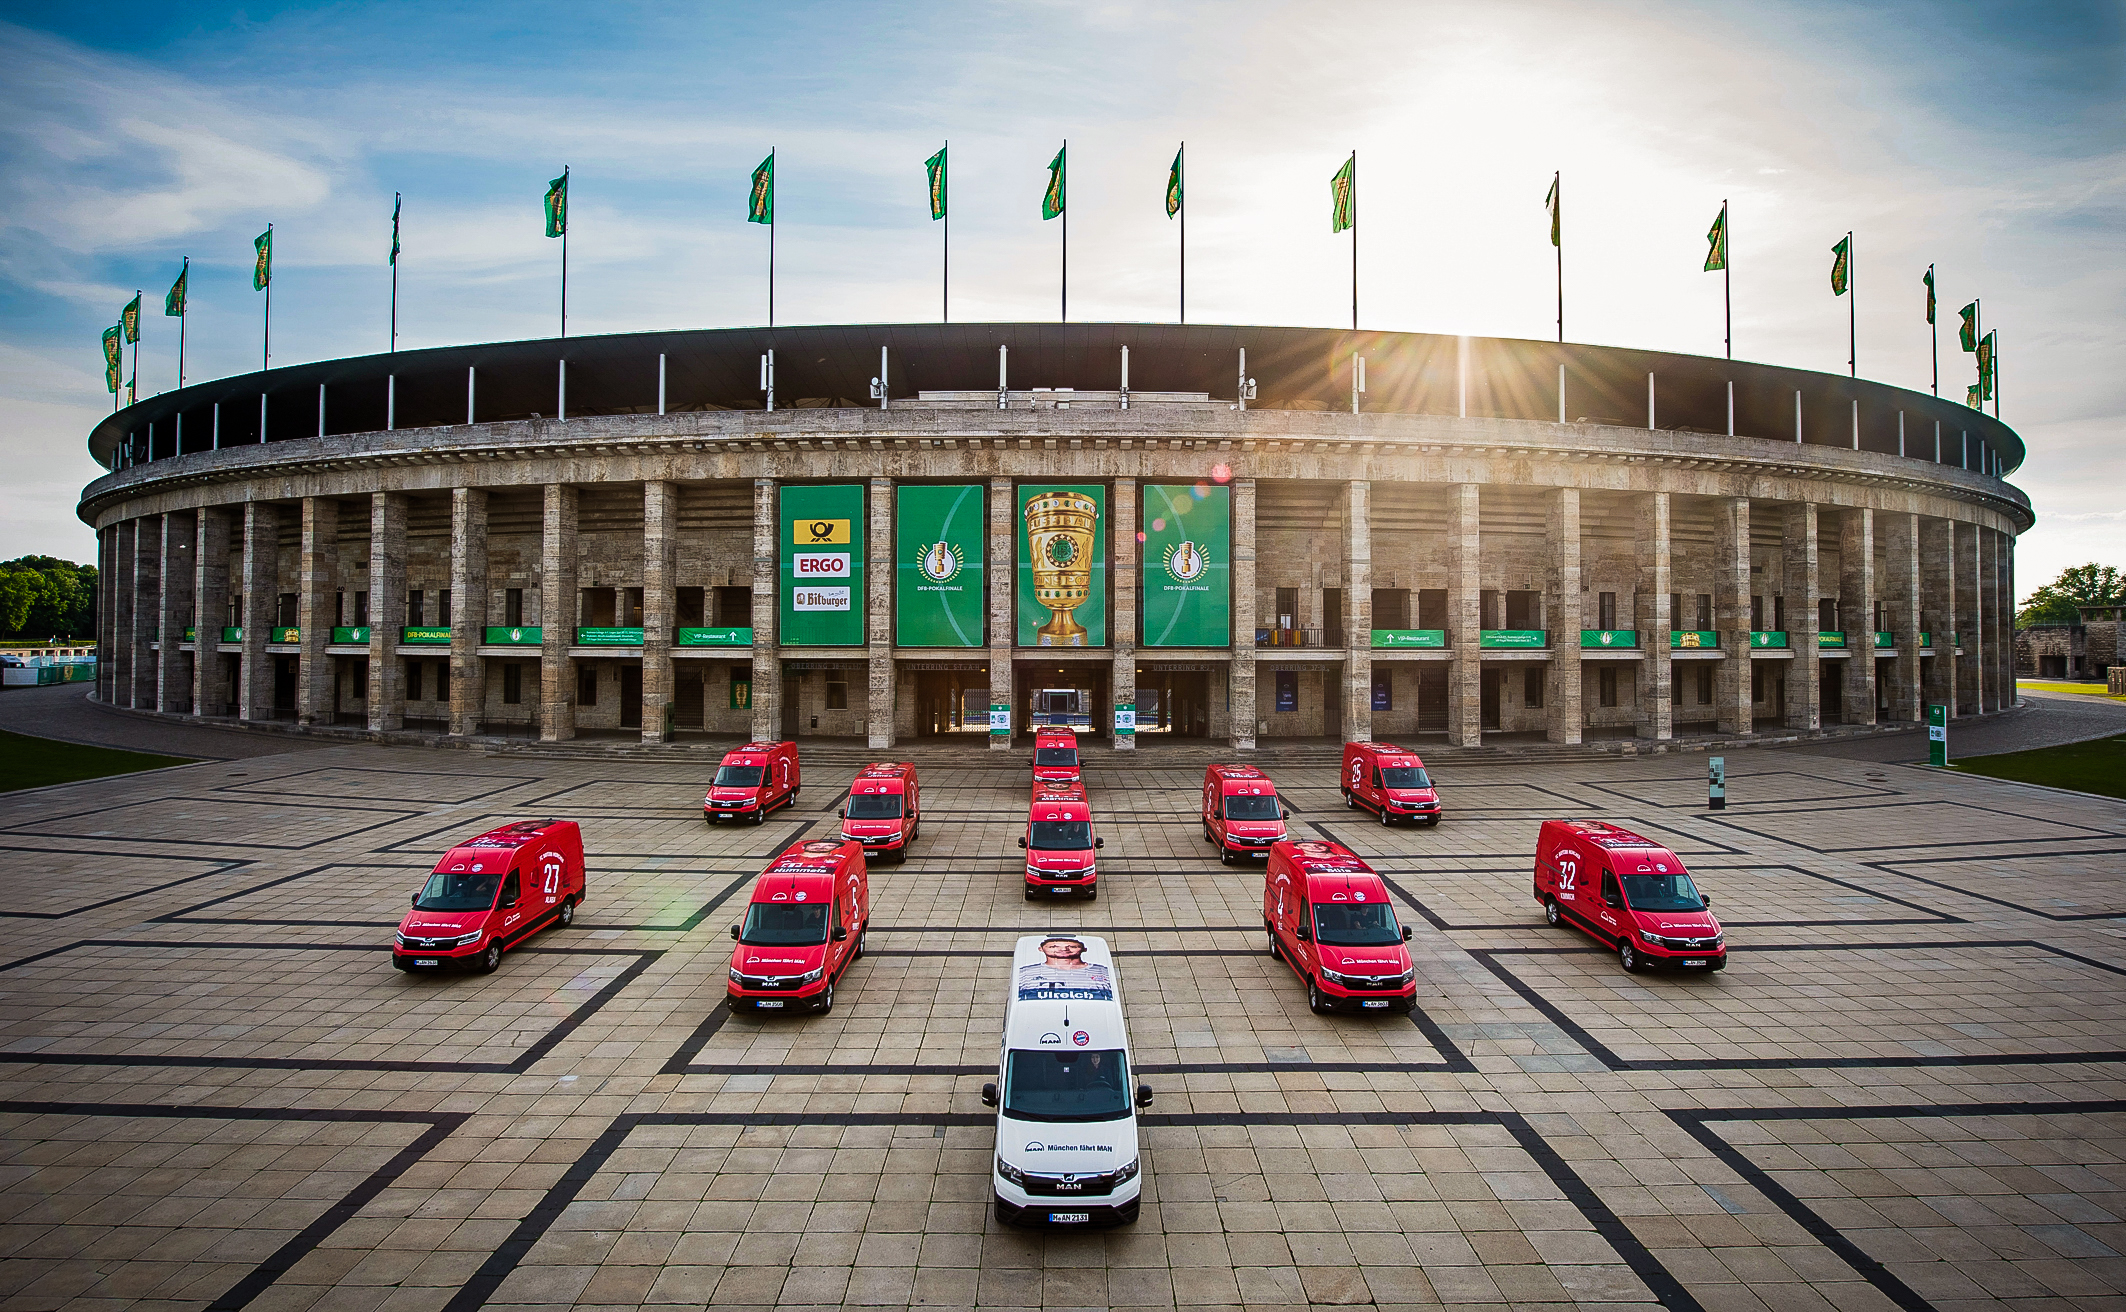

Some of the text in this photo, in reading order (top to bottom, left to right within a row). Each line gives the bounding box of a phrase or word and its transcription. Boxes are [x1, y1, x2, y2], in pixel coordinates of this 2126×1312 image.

[799, 558, 844, 572] ERGO
[807, 592, 848, 607] Bitburger
[1352, 763, 1361, 783] 25
[543, 863, 560, 894] 27
[1559, 861, 1576, 891] 32
[1037, 991, 1094, 999] Ulreich
[1047, 1144, 1078, 1152] München
[1079, 1144, 1096, 1152] fährt
[1096, 1145, 1113, 1153] MAN
[1071, 1213, 1088, 1222] 2131
